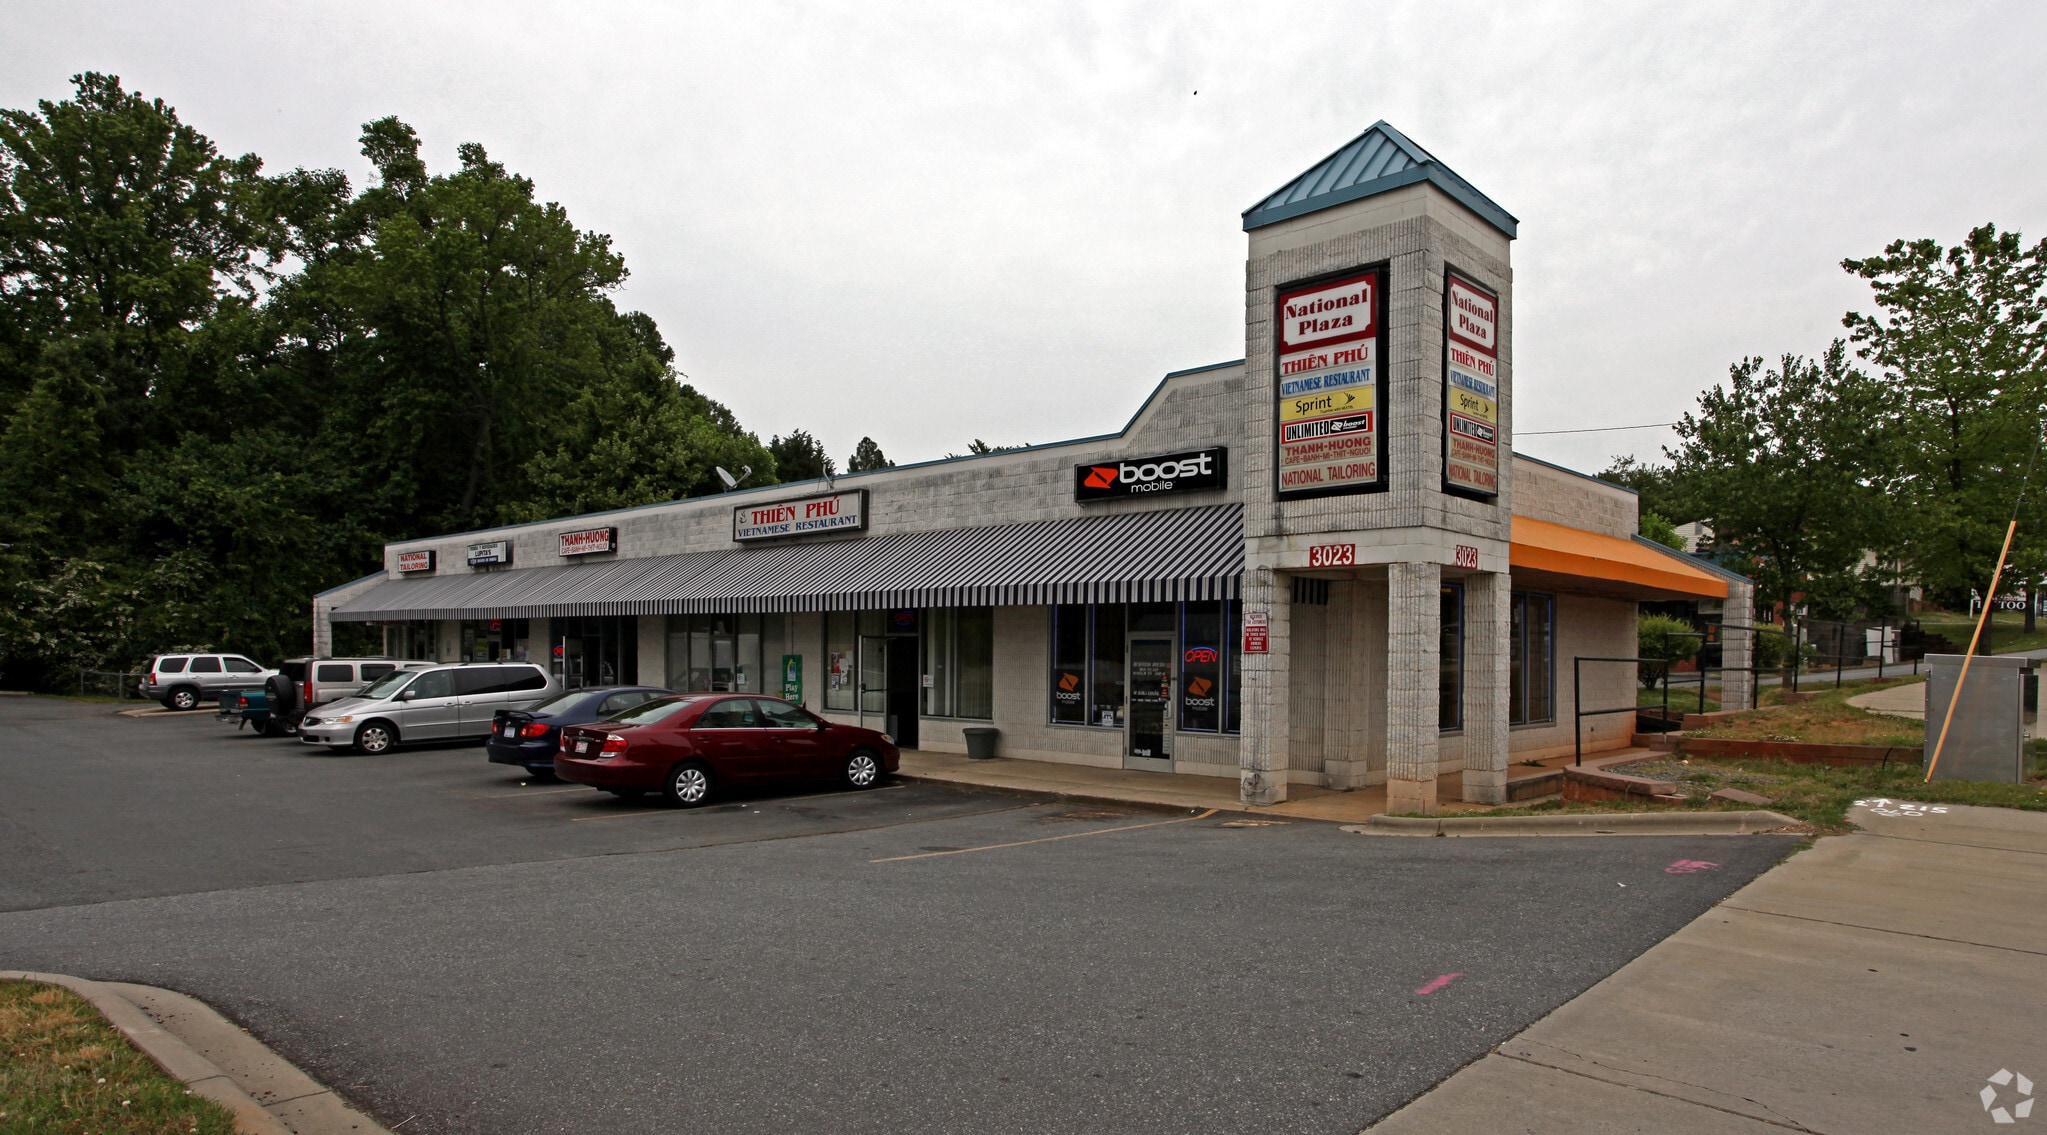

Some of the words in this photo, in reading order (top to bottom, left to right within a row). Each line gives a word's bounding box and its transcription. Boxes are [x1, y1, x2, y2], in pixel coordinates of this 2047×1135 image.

[1285, 288, 1367, 319] National
[1451, 290, 1493, 323] National
[1298, 315, 1353, 336] Plaza
[1459, 313, 1487, 340] Plaza
[1282, 354, 1328, 374] THIÊN
[1333, 344, 1368, 365] PHÚ
[1451, 347, 1476, 369] THIÊN
[1477, 360, 1494, 376] PHÚ
[1281, 377, 1321, 395] VIETNAMESE
[1324, 368, 1370, 387] RESTAURANT
[1295, 396, 1332, 415] Sprint
[1460, 393, 1479, 411] Sprint
[1286, 420, 1329, 440] UNLIMITED
[1285, 436, 1371, 456] THANH-HUONG
[1453, 438, 1495, 459] THANH-HUONG
[1119, 453, 1212, 484] boost
[1281, 469, 1324, 486] NATIONAL
[1327, 462, 1375, 480] TAILORING
[1448, 463, 1471, 482] NATIONAL
[1473, 469, 1496, 488] TAILORING
[1131, 481, 1173, 493] mobile
[751, 504, 796, 525] THIÊN
[806, 495, 840, 519] PHÚ
[738, 523, 790, 537] VIETNAMESE
[795, 515, 858, 531] RESTAURANT
[561, 529, 609, 546] THANH-HUONG
[400, 552, 427, 562] NATIONAL
[400, 561, 428, 571] TAILORING
[1312, 545, 1353, 566] 3023
[1456, 545, 1477, 568] 3023
[1185, 649, 1218, 663] OPEN
[785, 683, 798, 692] Play
[1056, 691, 1081, 700] boost
[1185, 696, 1215, 706] boost
